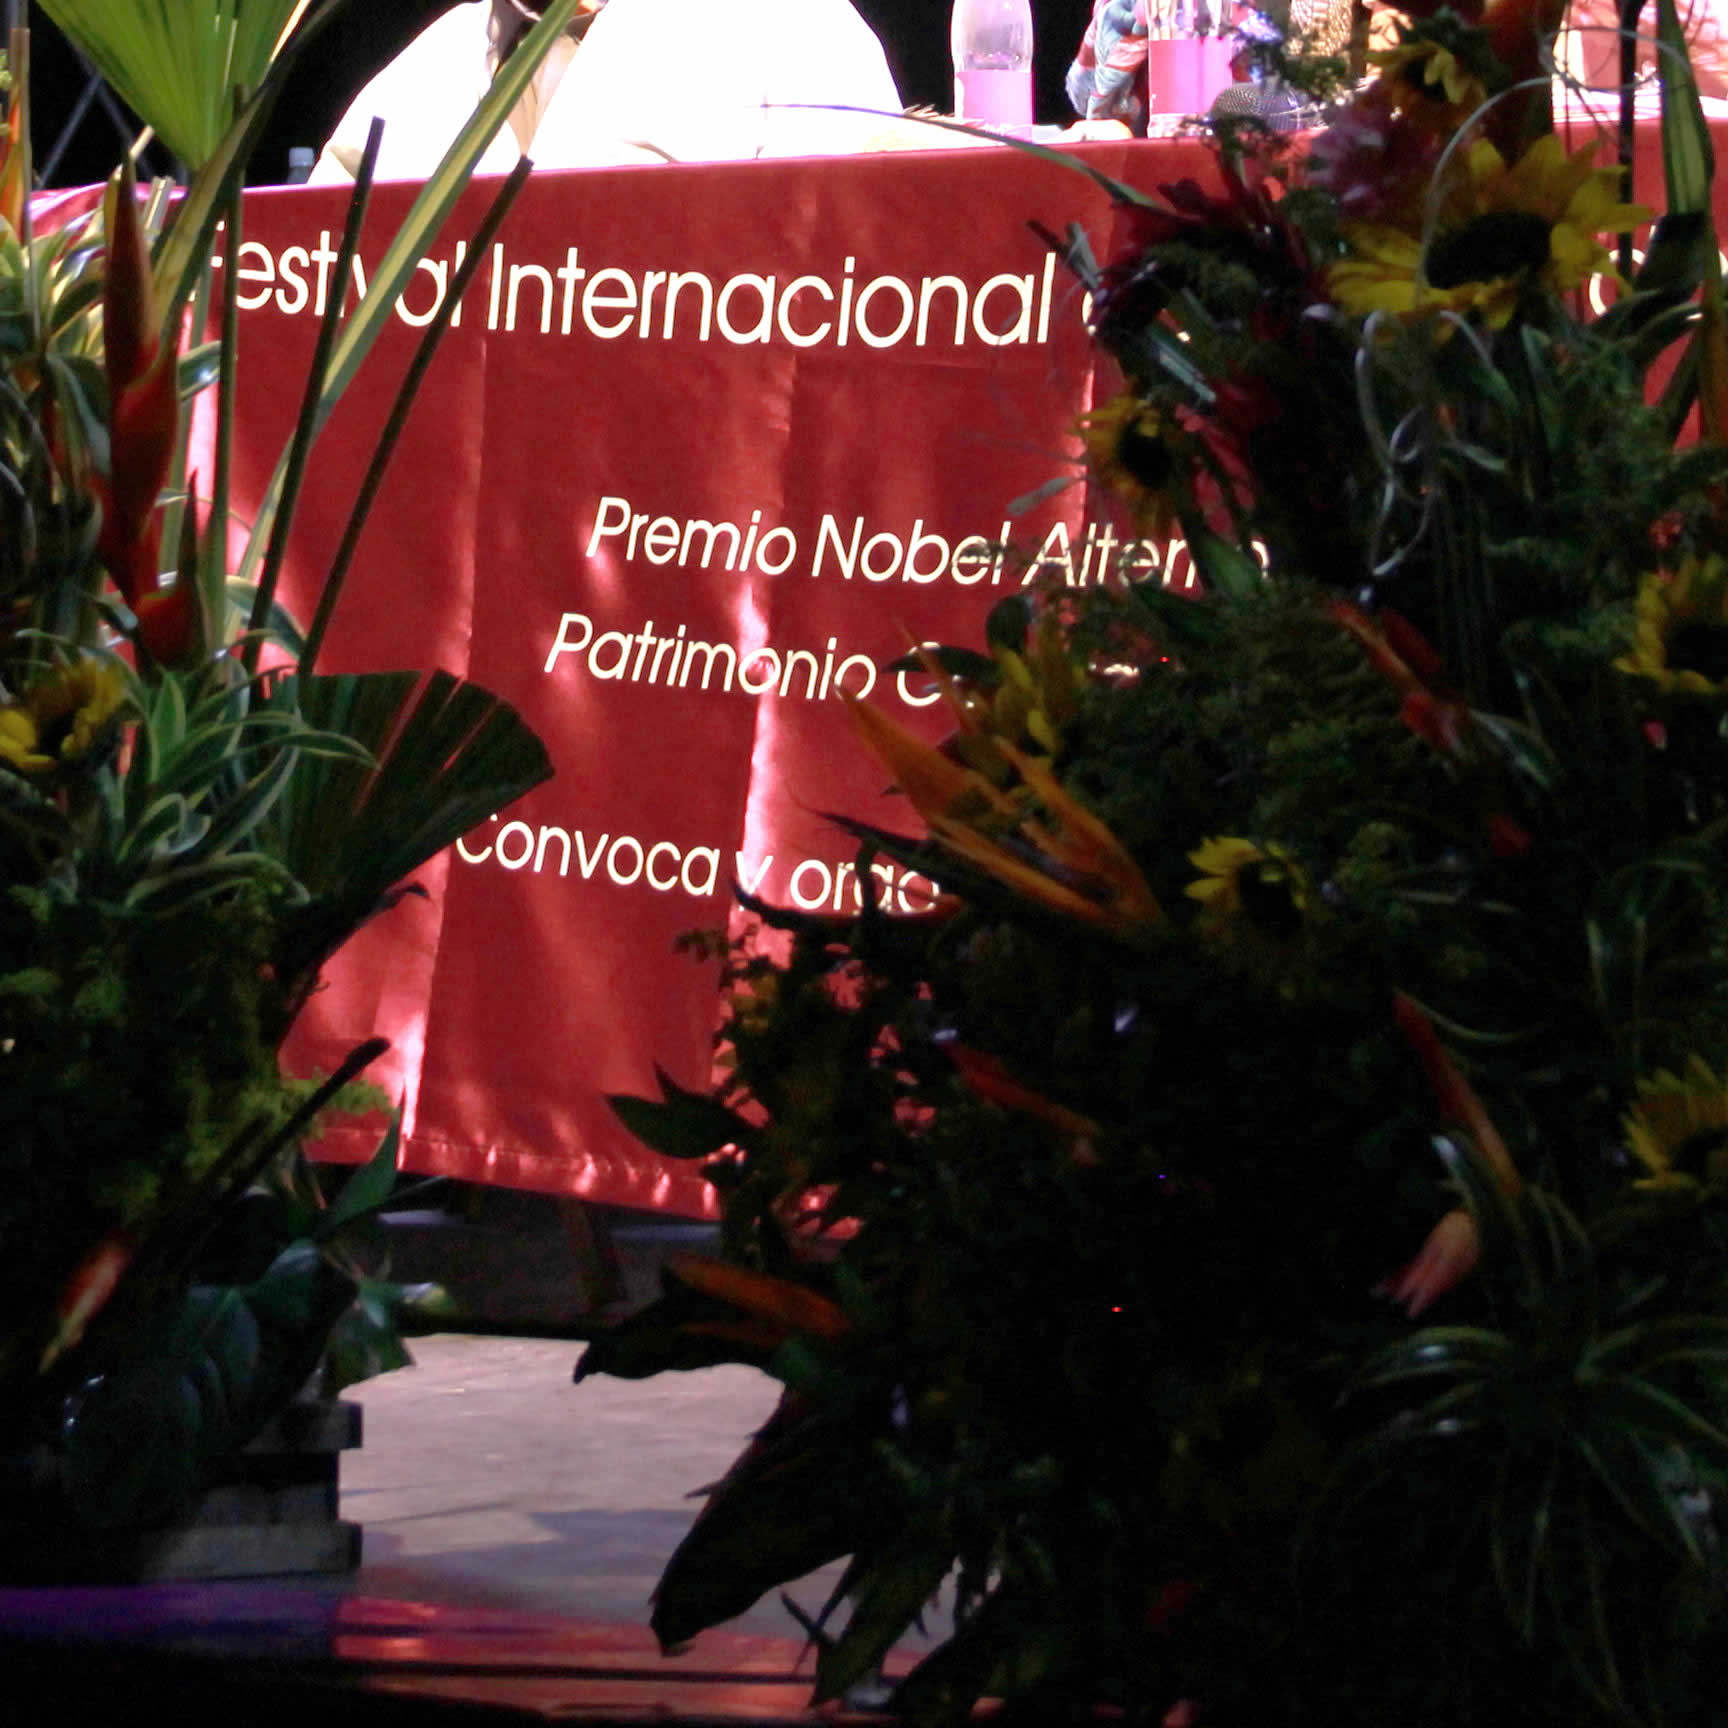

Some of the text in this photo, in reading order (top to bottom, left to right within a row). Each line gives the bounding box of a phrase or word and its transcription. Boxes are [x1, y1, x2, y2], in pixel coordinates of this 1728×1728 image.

[487, 242, 1057, 348] Internacional
[585, 496, 798, 577] Premio
[811, 513, 1011, 586] Nobel
[544, 612, 877, 703] Patrimonio
